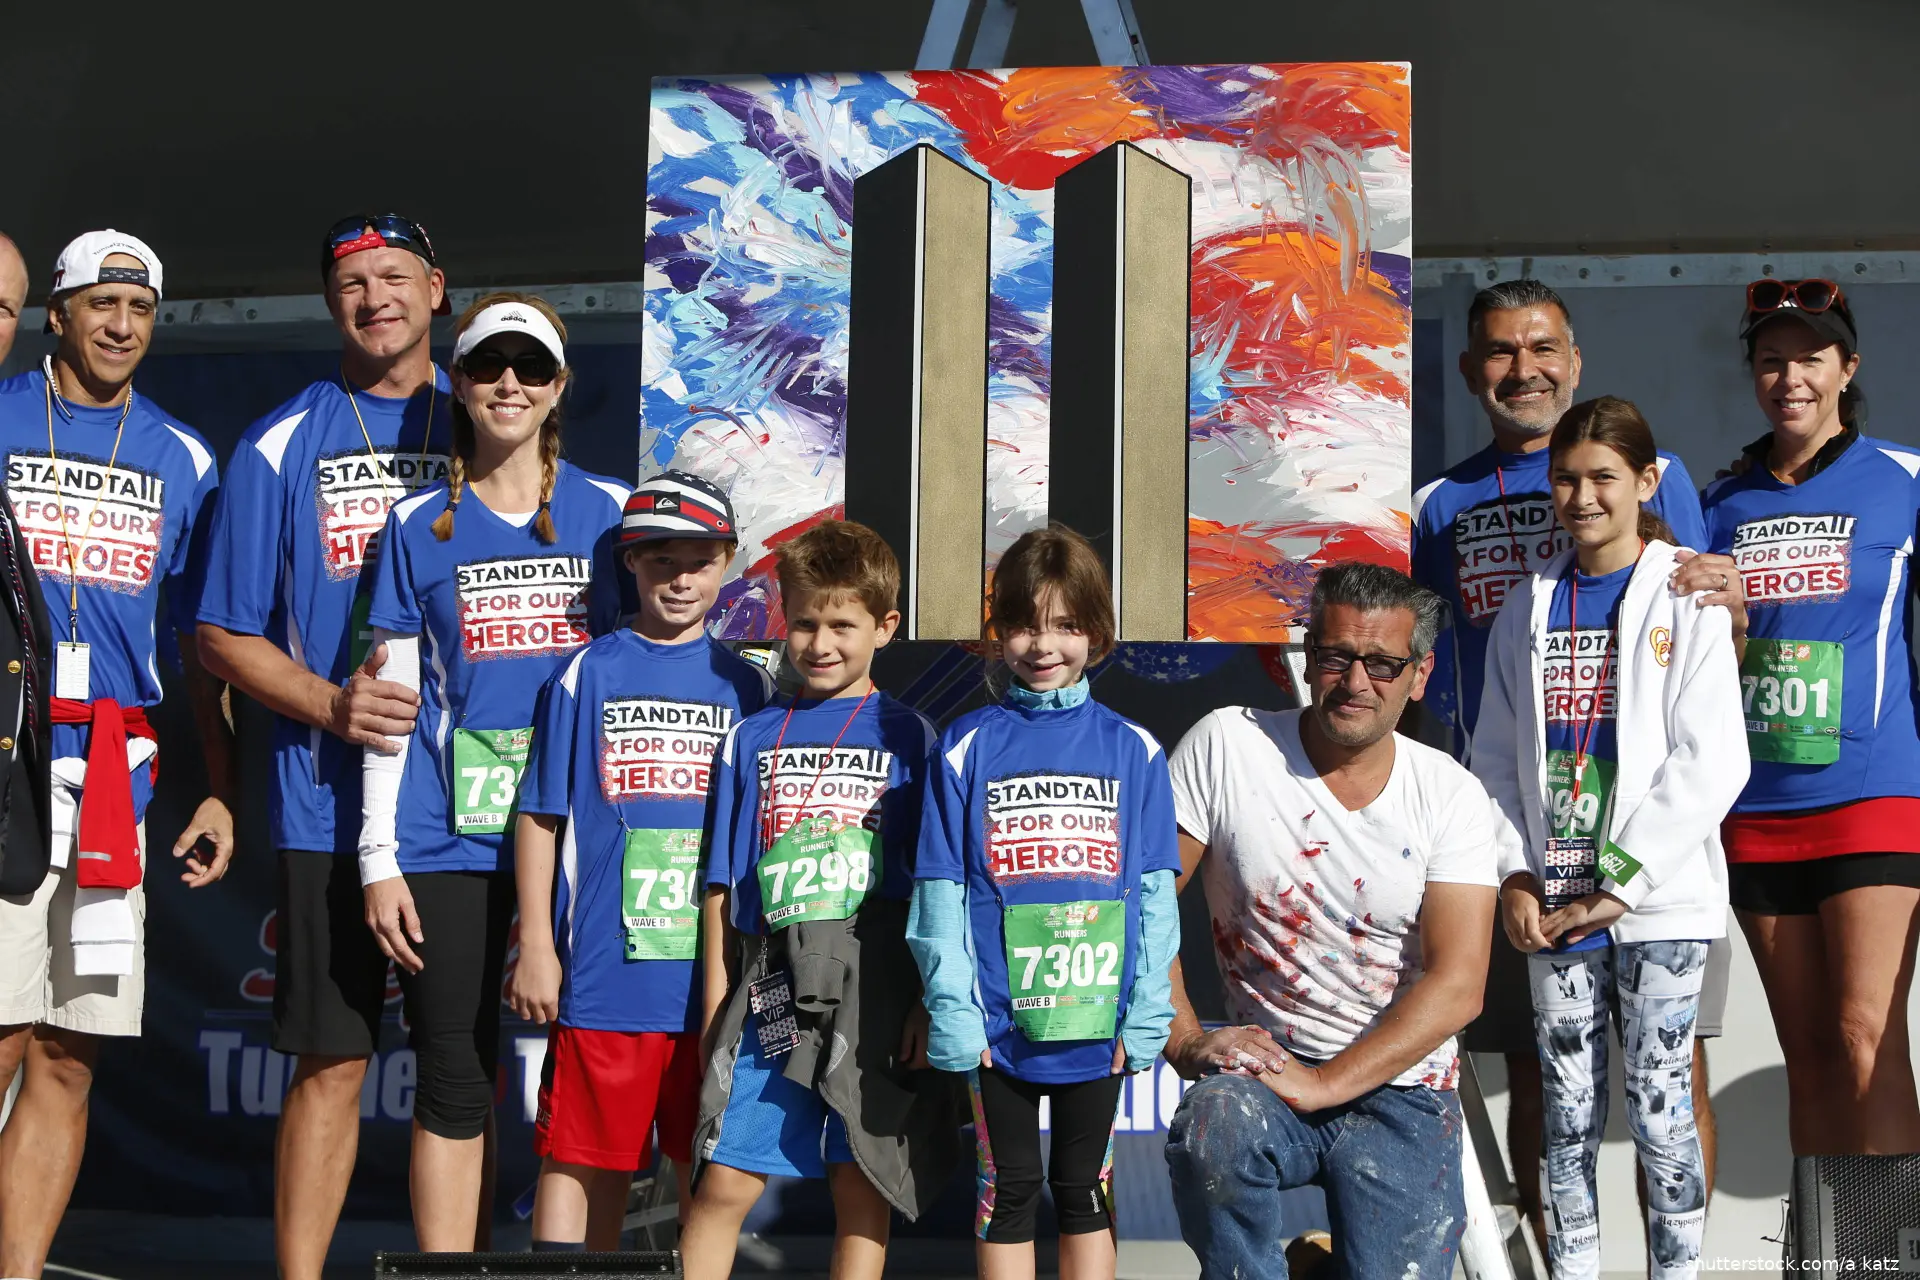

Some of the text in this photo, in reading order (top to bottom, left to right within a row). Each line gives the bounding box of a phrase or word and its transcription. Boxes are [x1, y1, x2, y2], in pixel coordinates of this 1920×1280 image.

[501, 315, 527, 324] adidas
[319, 459, 450, 485] STANDTA
[25, 501, 145, 535] FOR OUR
[24, 537, 152, 581] EROES
[1473, 537, 1574, 568] FOR OU
[1741, 544, 1831, 565] FOR OUR
[1740, 569, 1844, 598] EROES
[476, 592, 575, 613] FOR OUR
[465, 621, 588, 651] HEROES
[1768, 664, 1799, 673] RUNNERS
[1741, 675, 1829, 718] 7301
[1745, 722, 1758, 730] AVE
[620, 737, 716, 757] FOR OUR
[606, 766, 709, 791] HEROE
[772, 782, 869, 801] FOR OUR
[463, 814, 498, 824] WAVE B
[1006, 813, 1106, 834] FOR OUR
[800, 839, 835, 853] RUNNERS
[992, 843, 1117, 873] HEROES
[763, 850, 876, 905] 7298
[1556, 866, 1585, 878] VIP
[631, 917, 657, 927] WAVE
[659, 918, 665, 927] B
[770, 906, 792, 922] WAVE
[794, 904, 800, 914] B
[1054, 929, 1087, 939] RUNNERS
[1013, 941, 1119, 990] 7302
[762, 1005, 785, 1022] VIP
[1017, 998, 1042, 1009] WAVE
[1044, 997, 1050, 1006] B
